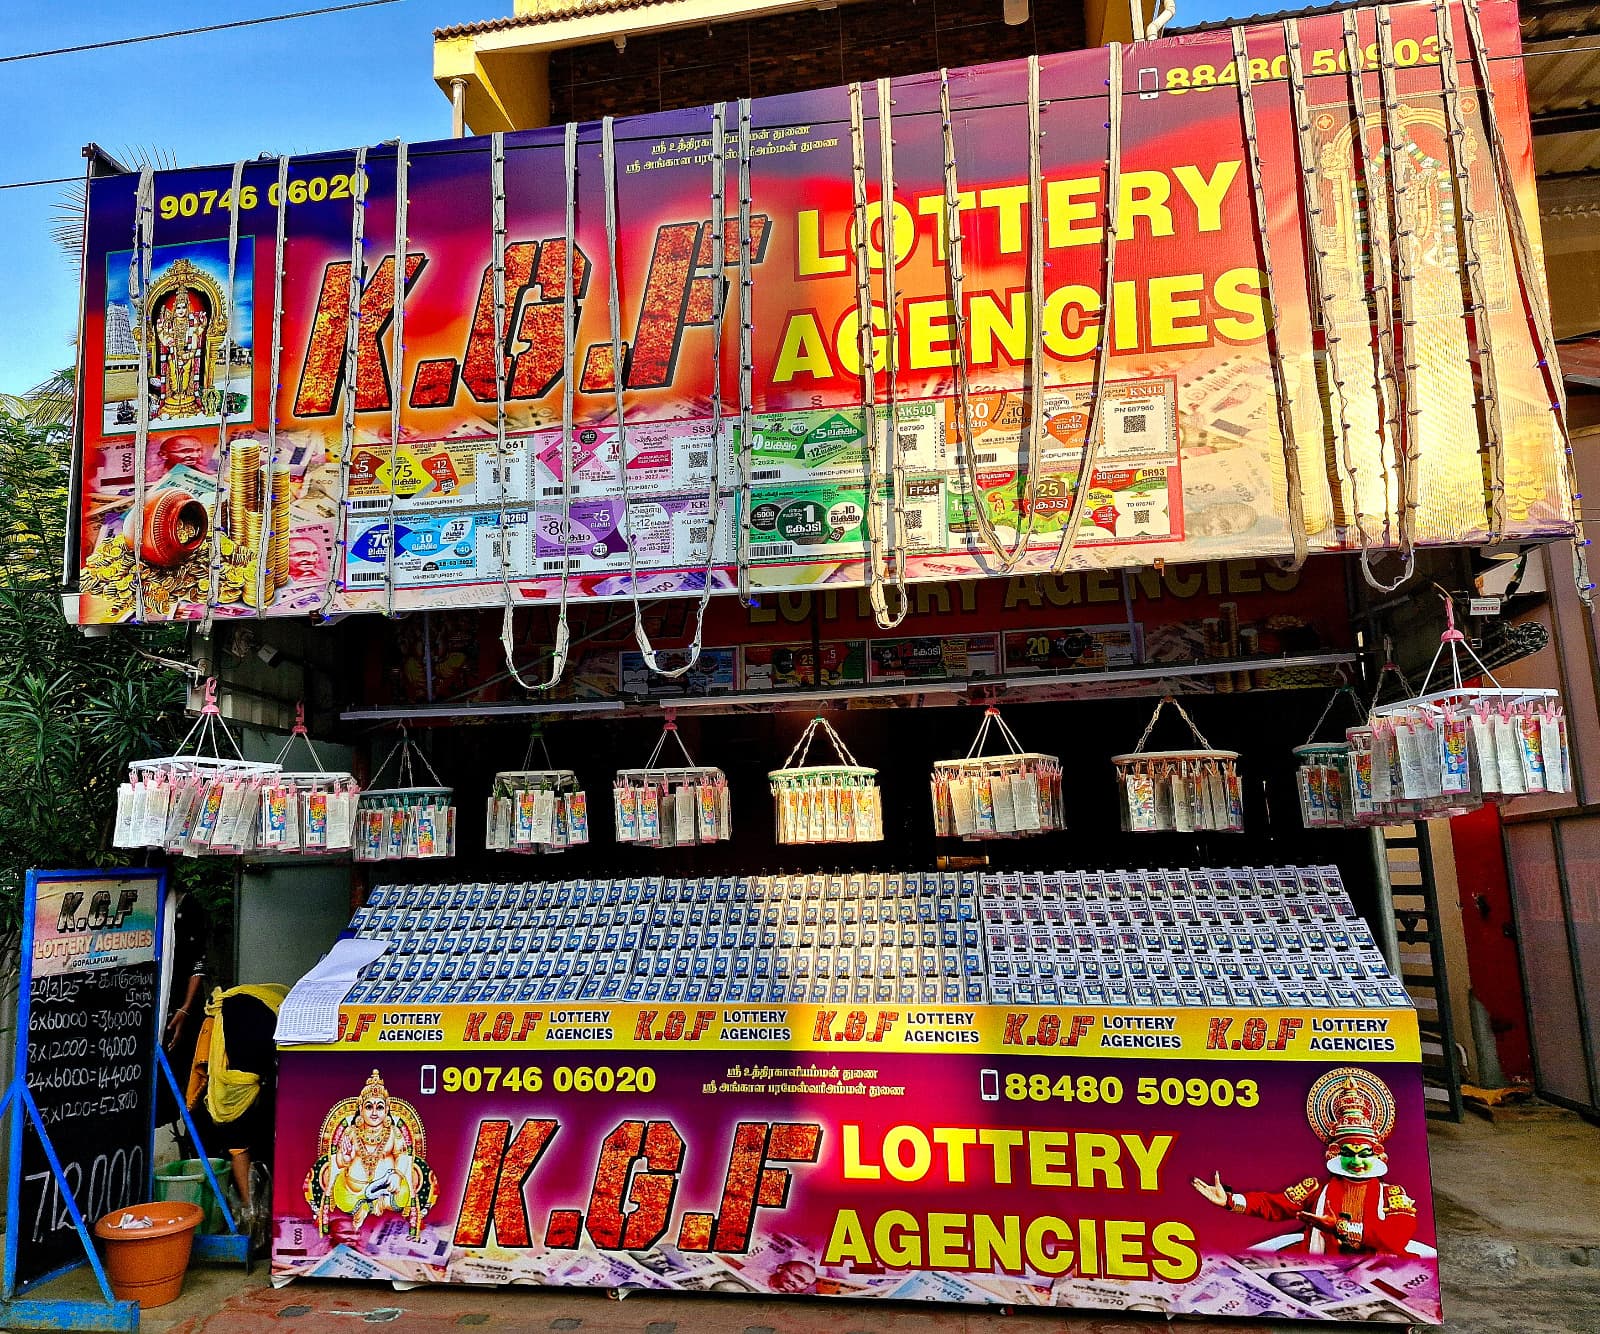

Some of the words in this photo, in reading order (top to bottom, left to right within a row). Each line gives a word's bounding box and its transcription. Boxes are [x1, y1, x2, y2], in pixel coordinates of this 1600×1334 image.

[160, 185, 258, 220] 90746
[268, 174, 369, 207] 06020
[798, 160, 1243, 277] LOTTERY
[772, 267, 1272, 384] AGENCIES
[909, 484, 939, 495] FF44
[34, 934, 93, 959] LOTTERY
[95, 930, 153, 952] AGENCIES
[383, 1012, 441, 1025] LOTTERY
[463, 1011, 542, 1042] K.G.F
[550, 1010, 610, 1024] LOTTERY
[634, 1010, 716, 1041] K.G.F
[723, 1010, 787, 1023] LOTTERY
[812, 1010, 899, 1042] K.G.F
[907, 1012, 974, 1025] LOTTERY
[1002, 1012, 1095, 1047] K.G.F
[1103, 1015, 1176, 1030] LOTTERY
[1311, 1018, 1389, 1032] LOTTERY
[379, 1028, 443, 1042] AGENCIES
[545, 1027, 613, 1040] AGENCIES
[720, 1027, 791, 1040] AGENCIES
[904, 1029, 980, 1043] AGENCIES
[1099, 1034, 1182, 1049] AGENCIES
[1206, 1017, 1304, 1051] K.G.F
[1309, 1036, 1396, 1051] AGENCIES
[443, 1066, 543, 1093] 90746
[553, 1066, 656, 1093] 06020
[1004, 1074, 1123, 1104] 88480
[1136, 1076, 1260, 1107] 50903
[842, 1125, 1173, 1191] LOTTERY
[454, 1119, 823, 1254] K.G.F
[825, 1209, 1200, 1280] AGENCIES
